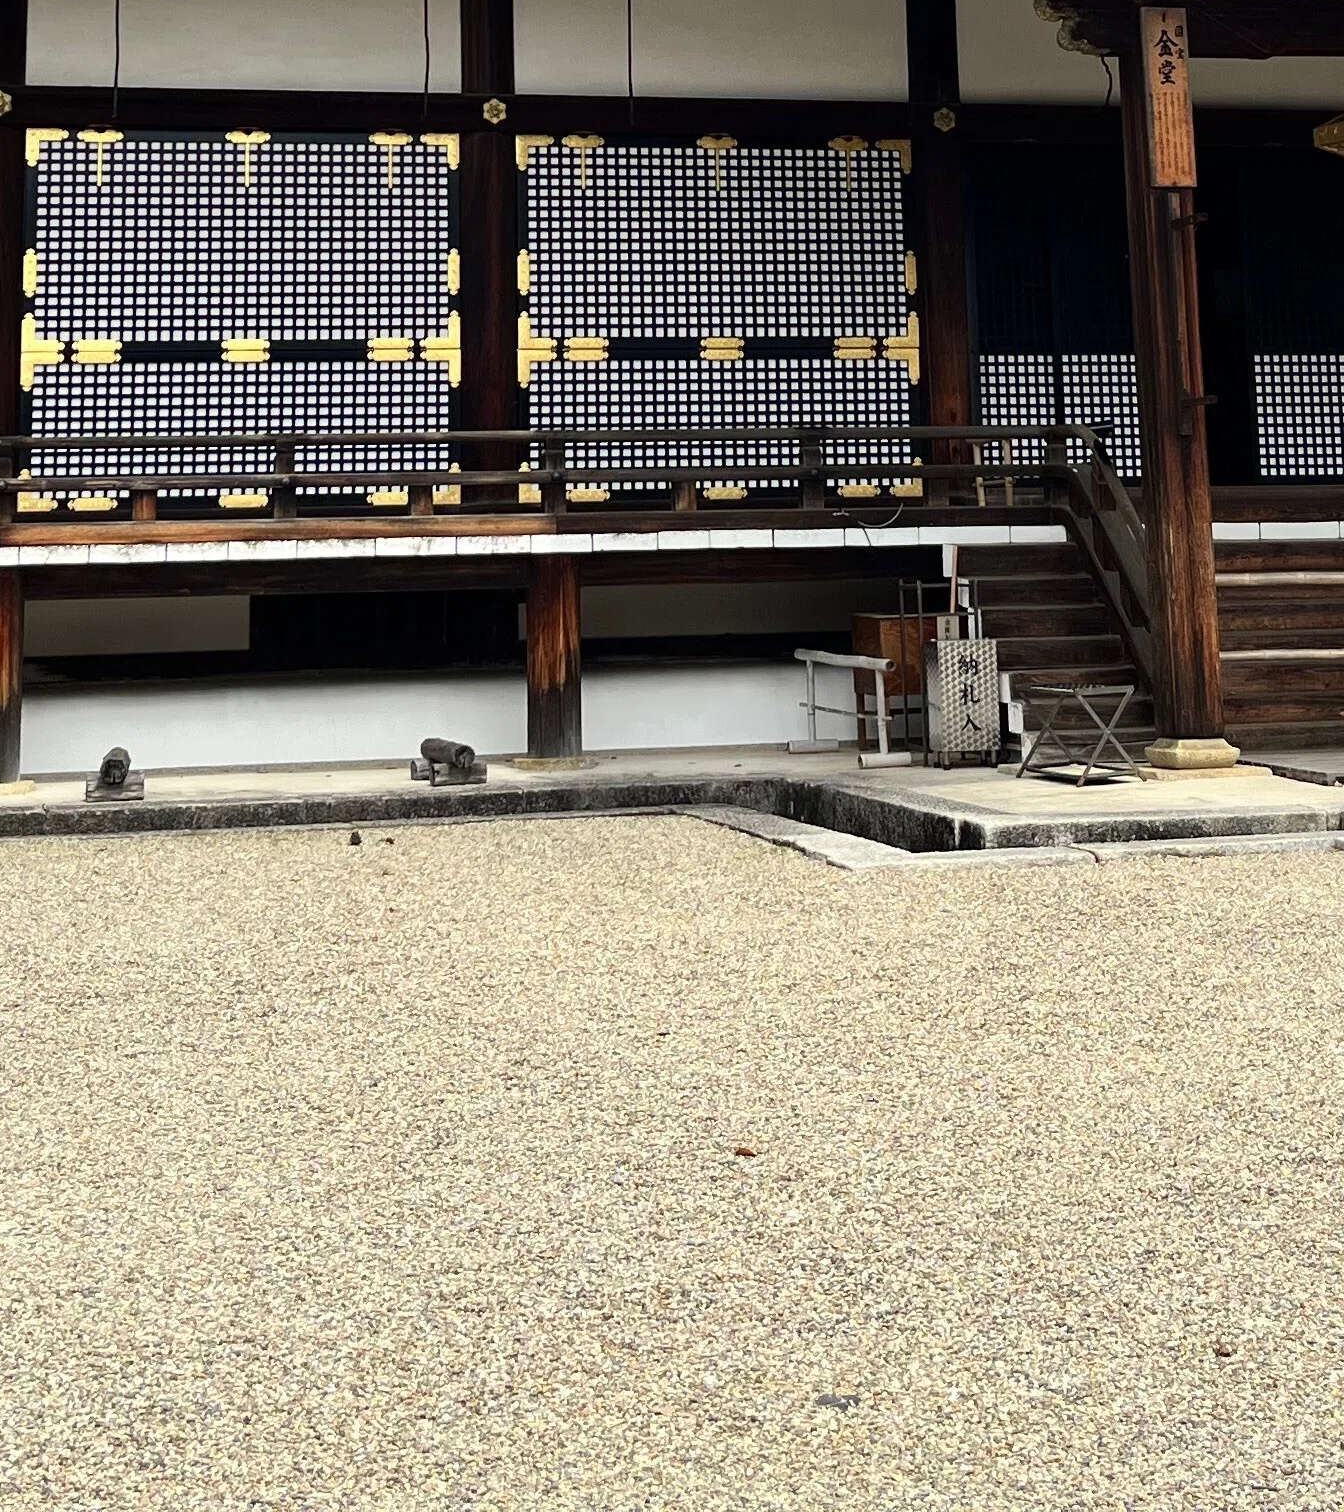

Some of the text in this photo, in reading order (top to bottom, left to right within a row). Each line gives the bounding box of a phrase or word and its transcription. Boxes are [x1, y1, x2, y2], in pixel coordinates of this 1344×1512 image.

[1153, 29, 1179, 85] 金堂
[958, 654, 981, 731] 納札入
